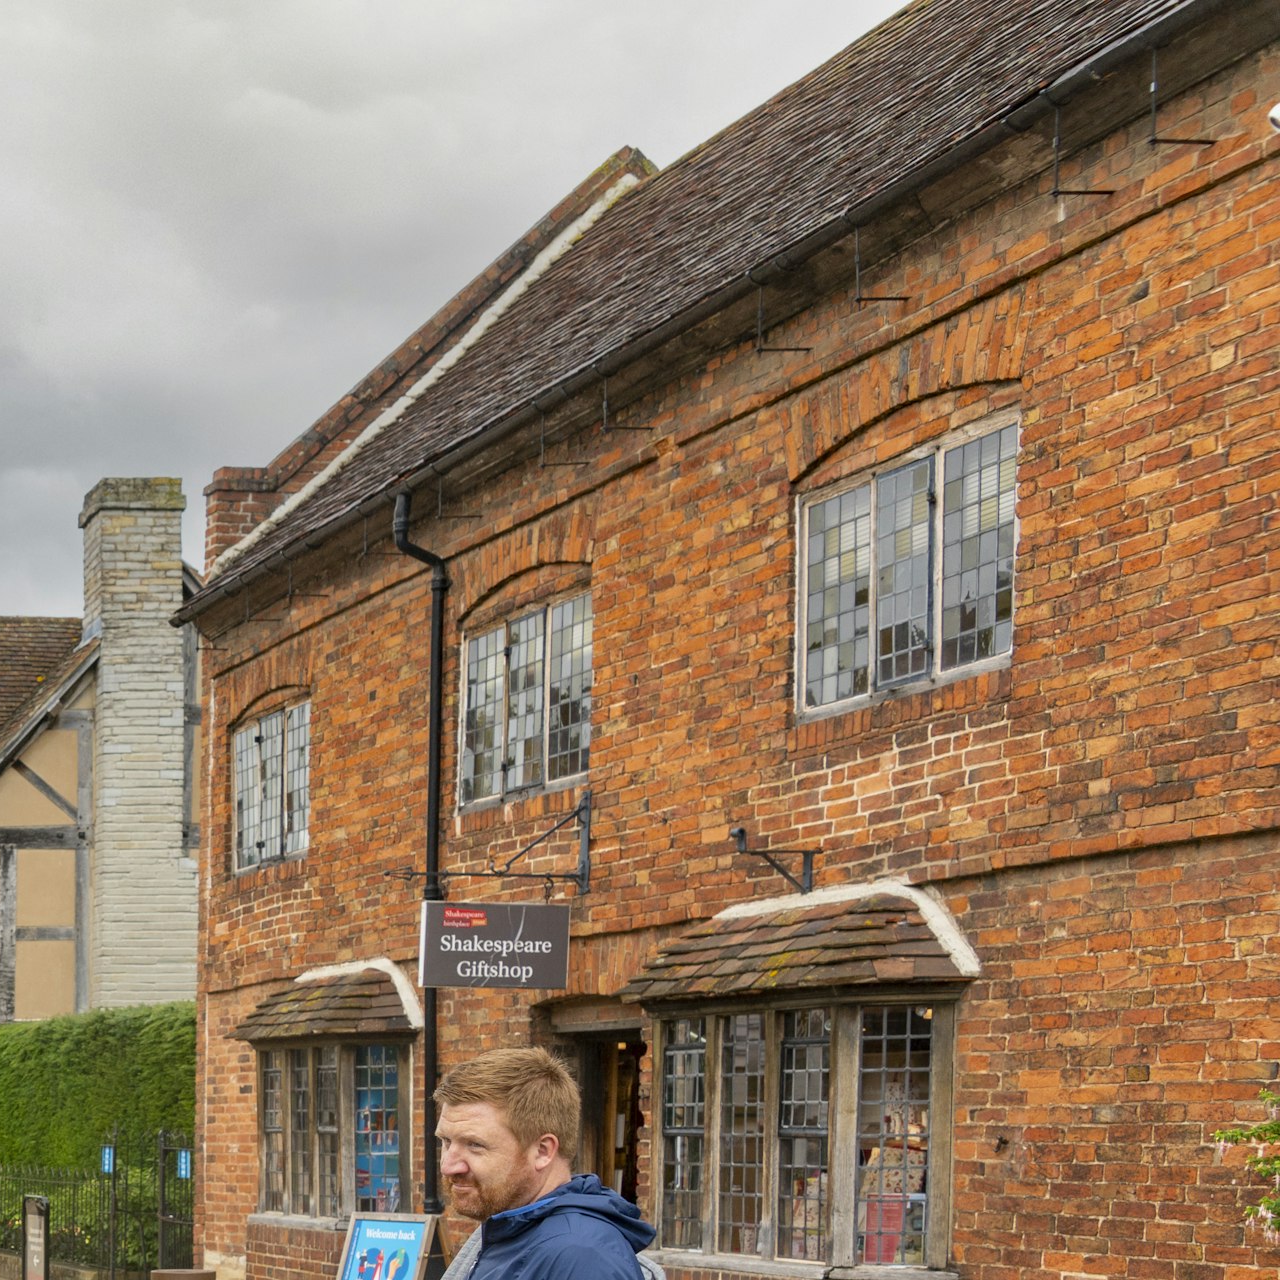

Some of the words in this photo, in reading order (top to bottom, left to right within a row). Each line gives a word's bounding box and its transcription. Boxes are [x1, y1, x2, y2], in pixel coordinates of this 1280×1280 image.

[440, 934, 552, 957] Shakespeare
[456, 960, 533, 982] Giftshop
[366, 1228, 398, 1240] Welcome
[398, 1229, 416, 1241] back
